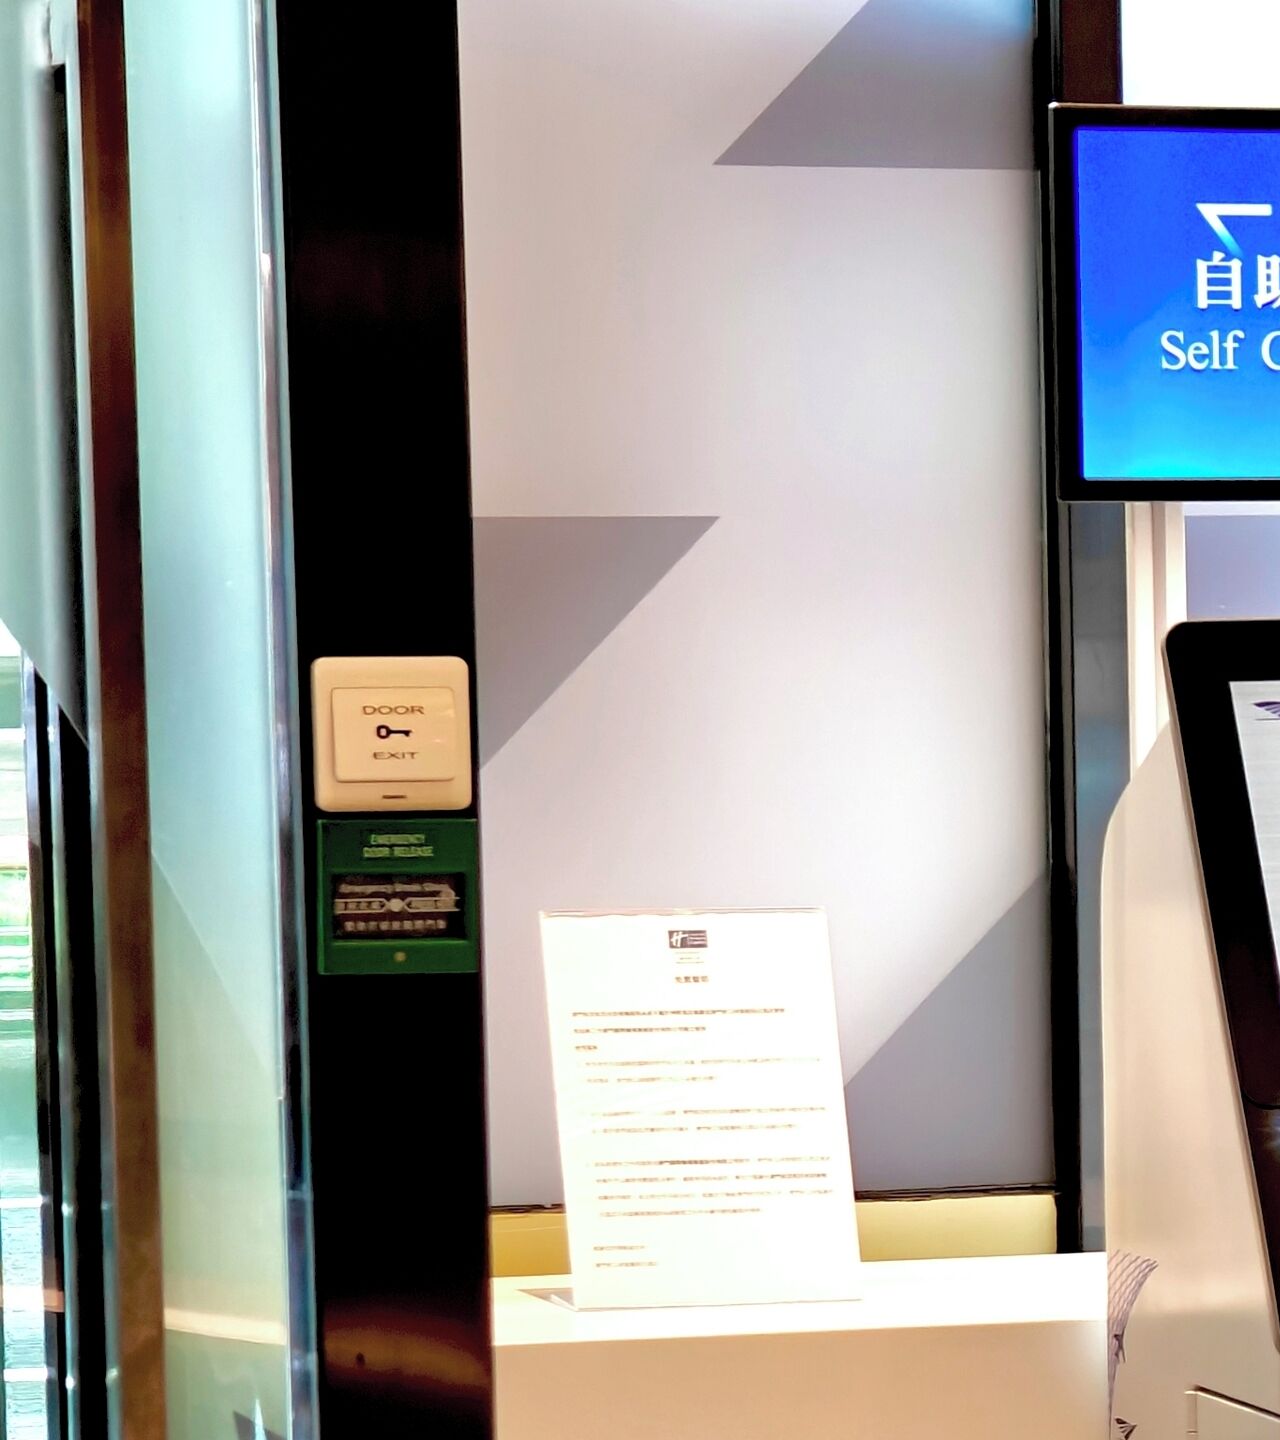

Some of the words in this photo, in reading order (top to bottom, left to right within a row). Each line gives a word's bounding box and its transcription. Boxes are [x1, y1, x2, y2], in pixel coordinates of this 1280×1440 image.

[1159, 329, 1244, 373] Self
[362, 705, 425, 715] DOOR
[372, 751, 419, 760] EXIT
